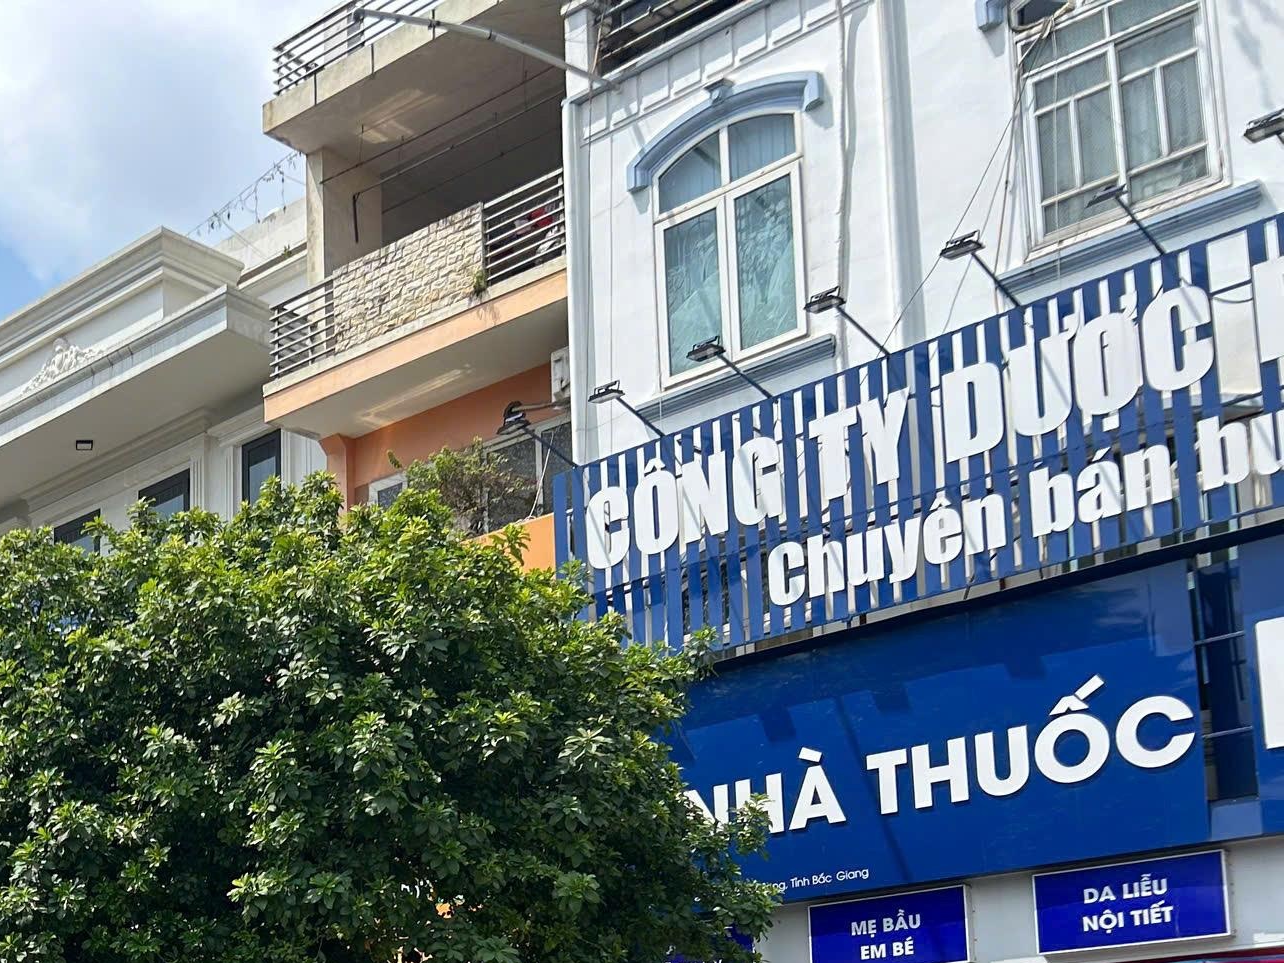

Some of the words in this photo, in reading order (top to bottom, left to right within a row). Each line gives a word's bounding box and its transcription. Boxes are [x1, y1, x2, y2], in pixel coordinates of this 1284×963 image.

[585, 436, 785, 570] CÔNG
[809, 386, 911, 501] TY
[941, 283, 1215, 463] DƯỢC
[1029, 444, 1173, 538] bán
[866, 674, 1196, 815] THUỐC
[836, 868, 869, 881] Giang
[1083, 885, 1116, 904] DA
[1122, 873, 1168, 899] LIỄU
[851, 919, 877, 938] MẸ
[882, 909, 921, 932] BẦU
[1082, 909, 1125, 934] NỘI
[1130, 900, 1174, 926] TIẾT
[860, 943, 886, 960] EM
[892, 936, 914, 957] BÉ
